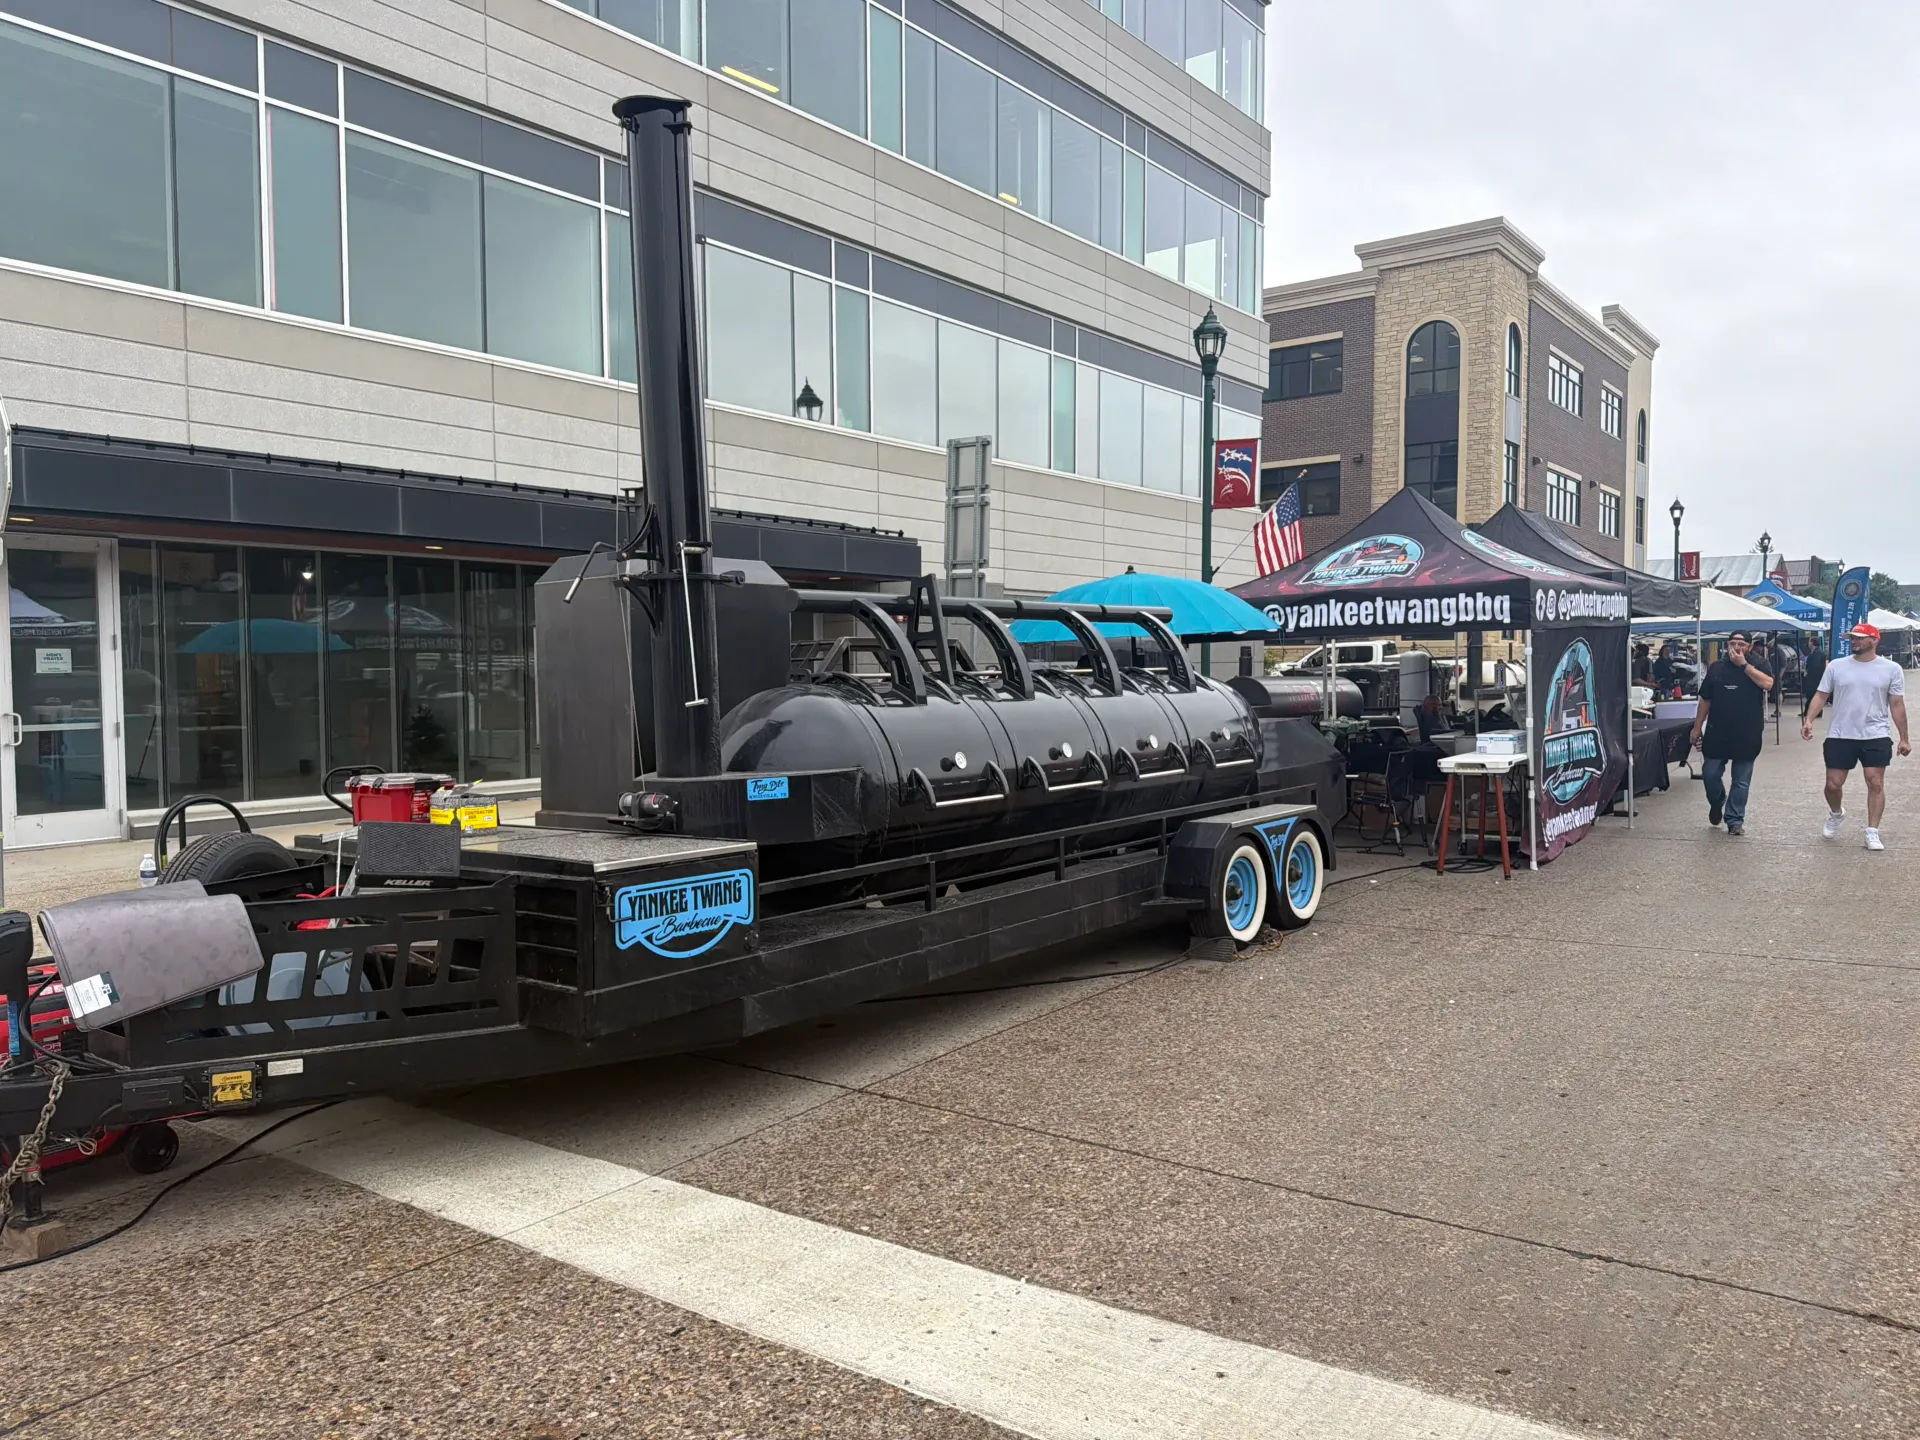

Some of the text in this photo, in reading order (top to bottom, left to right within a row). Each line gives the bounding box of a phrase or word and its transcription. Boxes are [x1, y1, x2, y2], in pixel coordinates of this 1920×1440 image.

[1312, 567, 1360, 579] YANKEE
[1361, 563, 1409, 576] TWANG
[1262, 592, 1511, 632] @yankeetwangbbq
[1558, 589, 1628, 621] @yankeetwangbbq
[1798, 611, 1817, 619] #128
[1847, 601, 1855, 619] #128
[1545, 733, 1597, 768] YANKEE TWANG
[384, 879, 433, 887] KELLER
[628, 879, 742, 922] YANKEE TWANG
[655, 913, 722, 942] Barbecue
